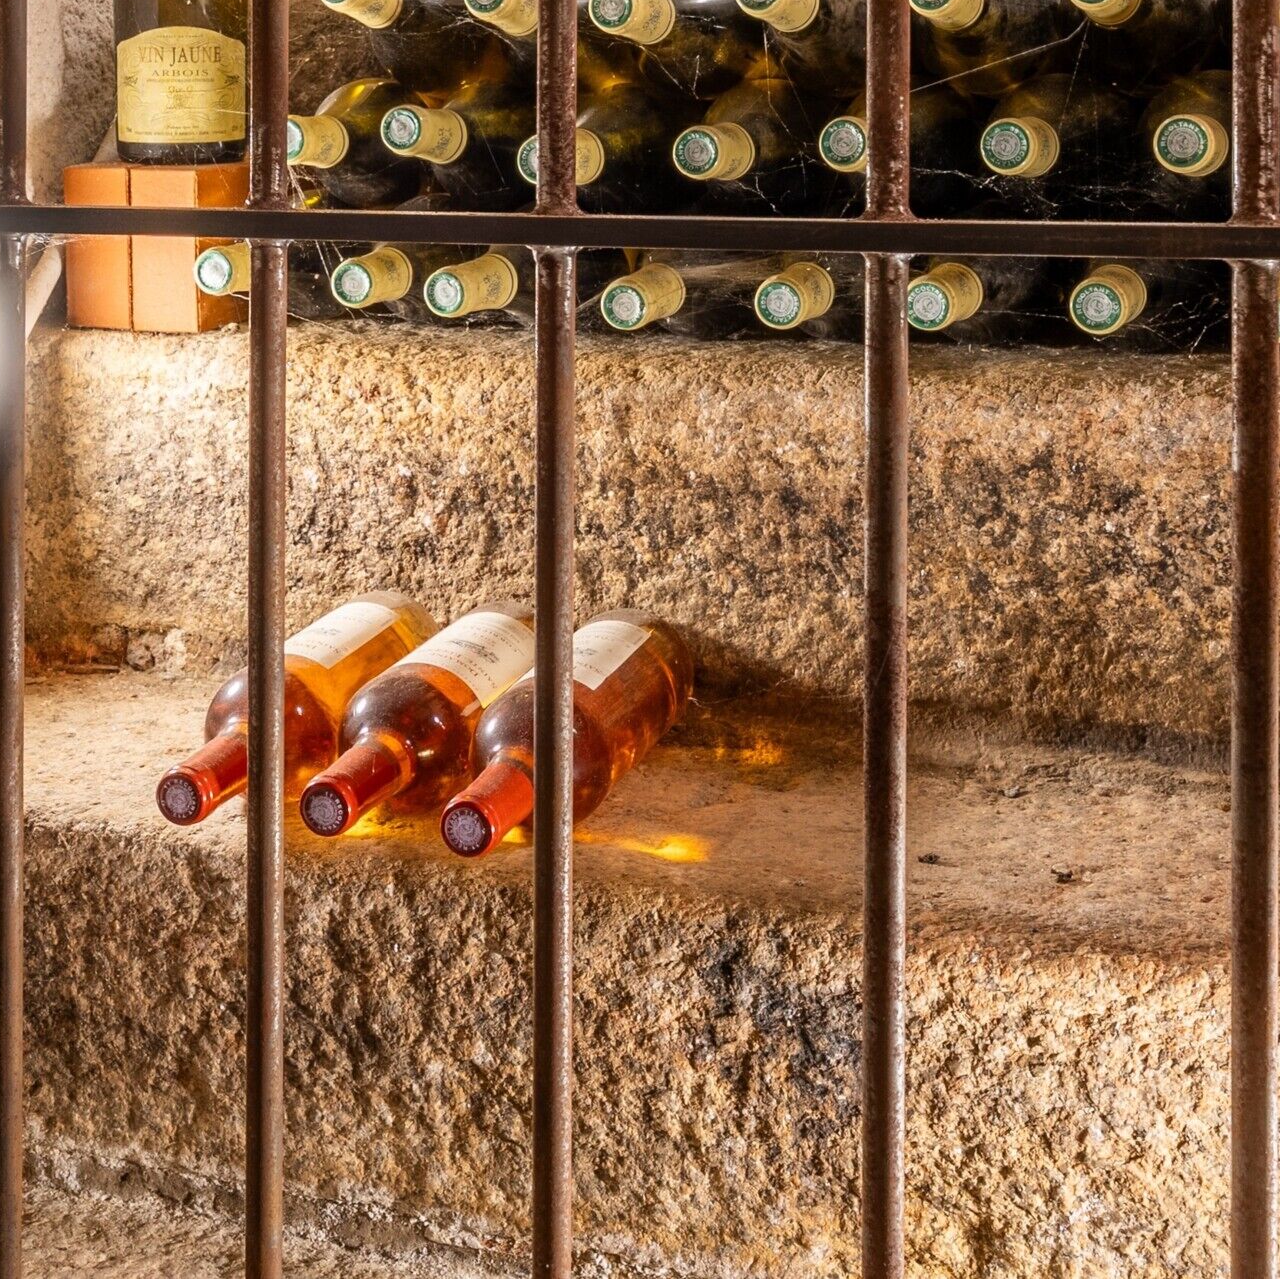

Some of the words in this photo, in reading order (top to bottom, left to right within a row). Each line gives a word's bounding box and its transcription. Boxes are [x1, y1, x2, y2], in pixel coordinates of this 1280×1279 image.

[138, 45, 164, 64] VIN
[169, 46, 222, 67] JAUNE
[151, 69, 209, 77] ARBOIS
